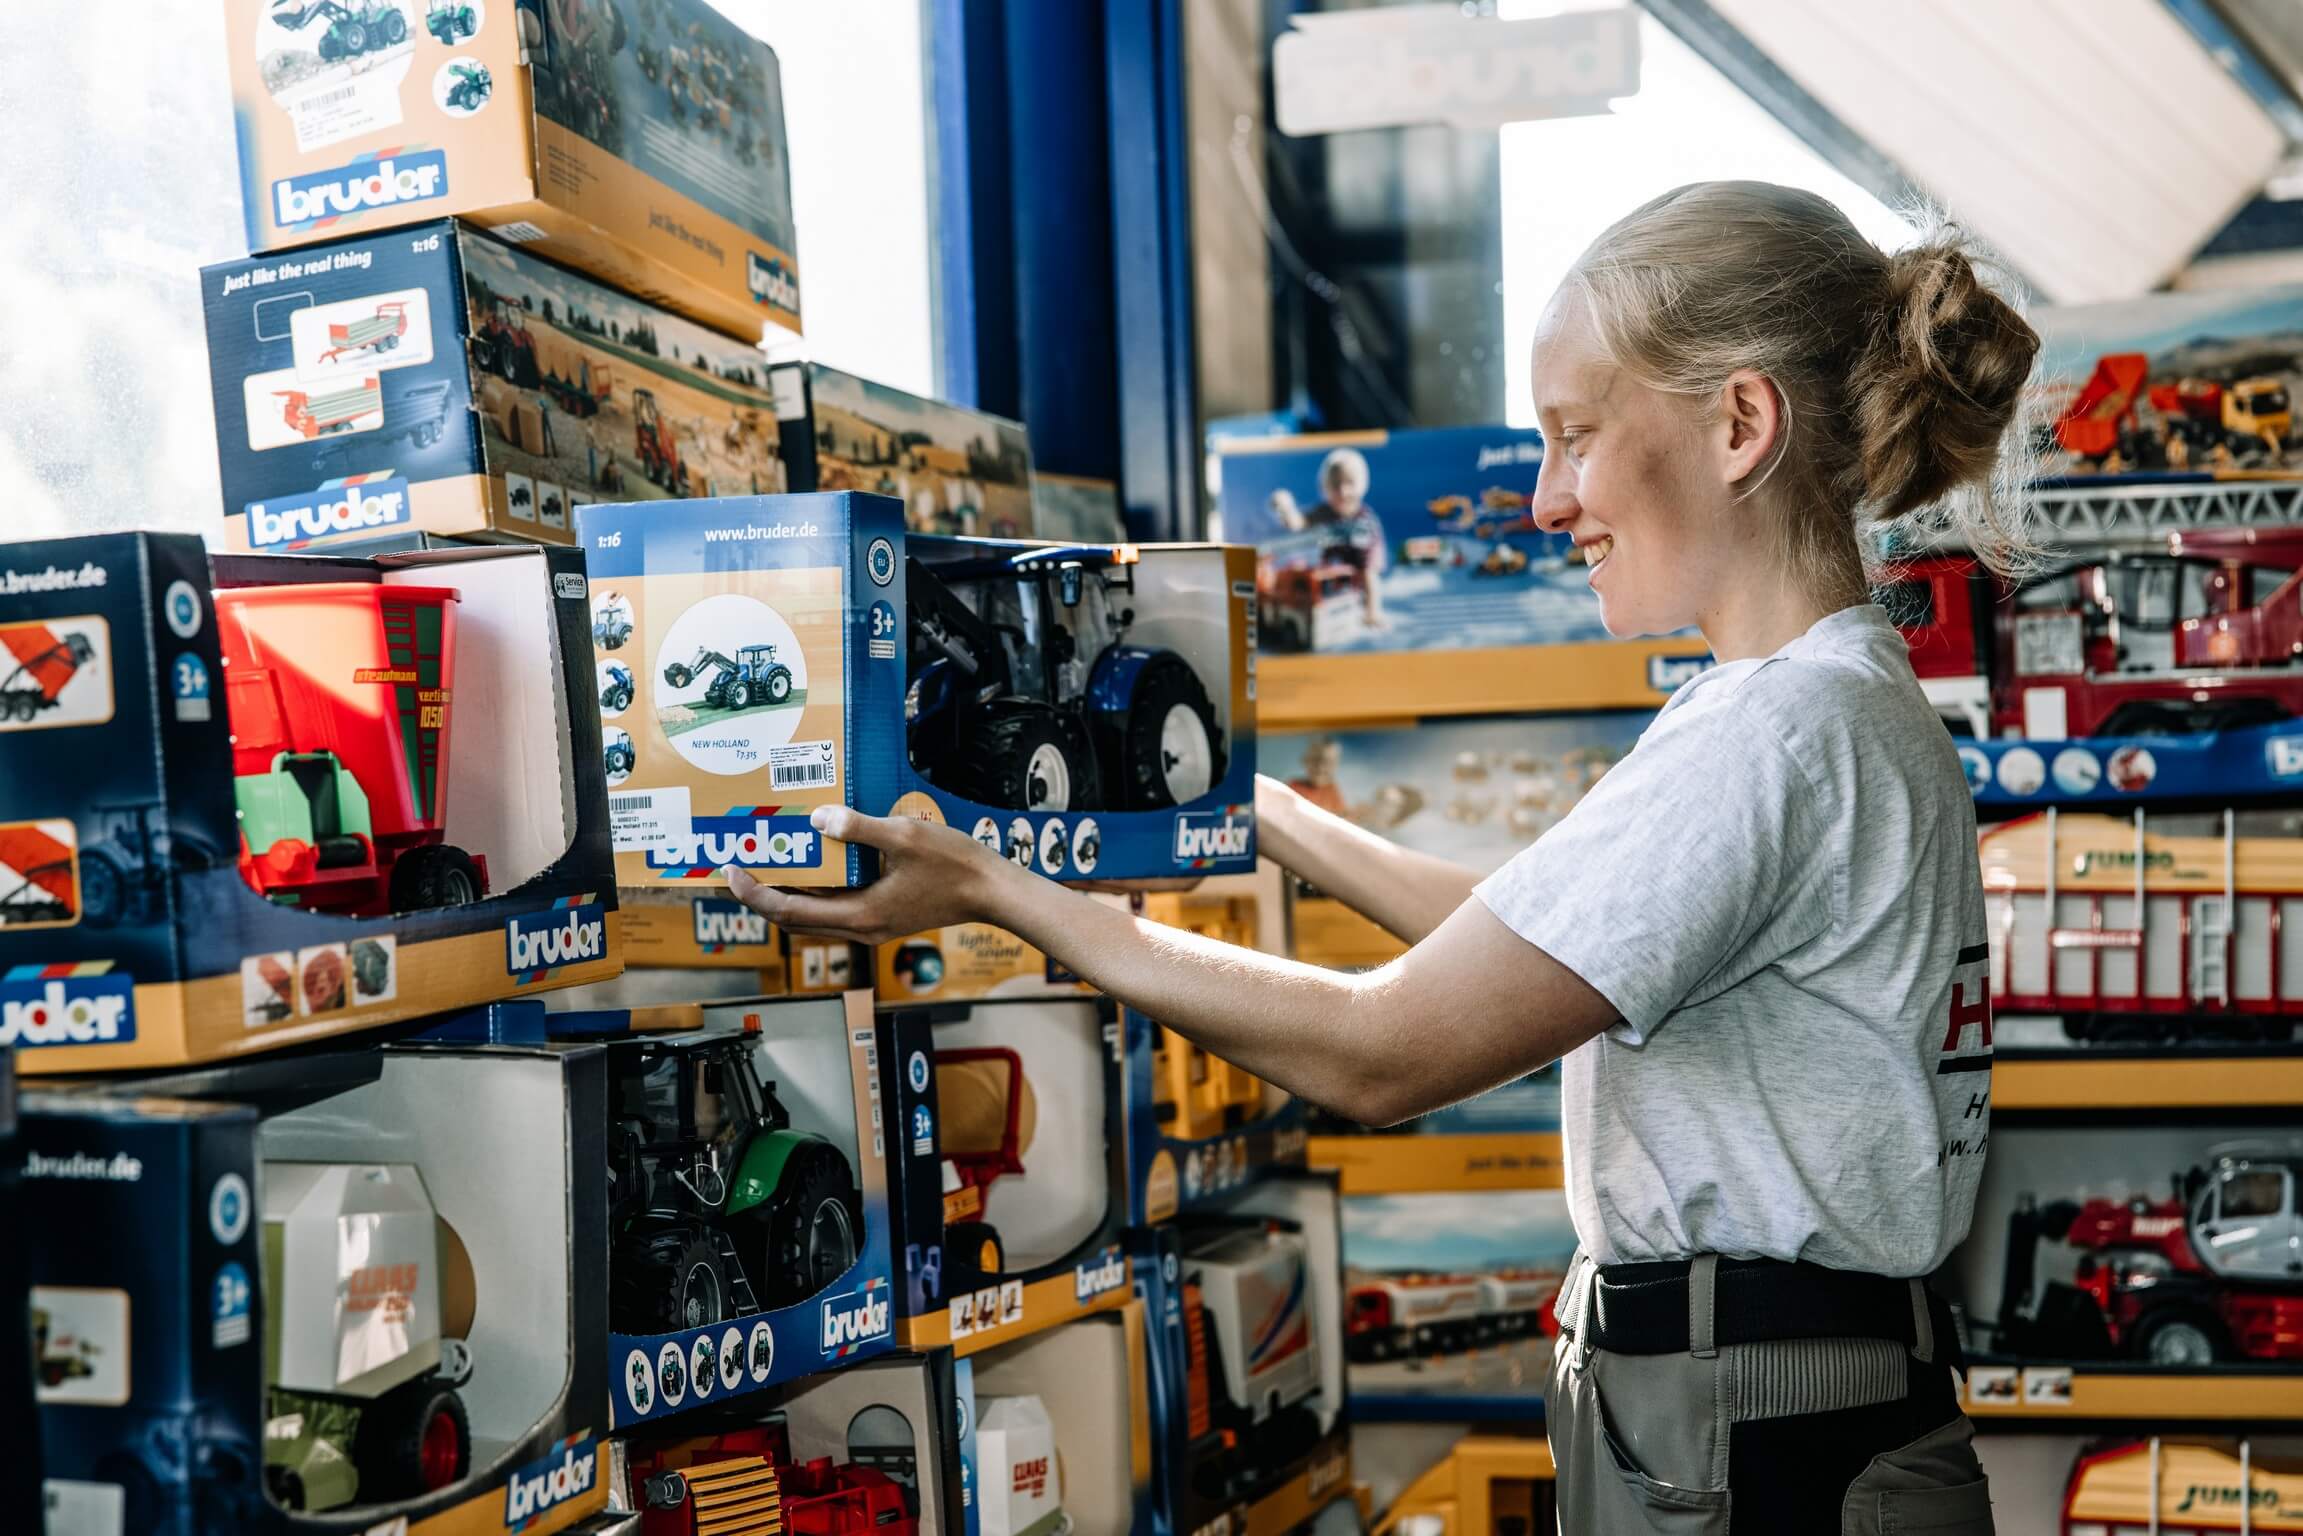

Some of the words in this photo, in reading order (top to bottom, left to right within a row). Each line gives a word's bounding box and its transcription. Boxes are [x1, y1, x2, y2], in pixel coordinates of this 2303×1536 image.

[277, 160, 439, 224] bruder
[411, 235, 439, 253] 1:16
[222, 274, 250, 297] just
[252, 266, 277, 286] like
[278, 262, 302, 281] the
[304, 256, 332, 276] real
[334, 251, 373, 270] thing
[252, 487, 404, 546] bruder
[704, 521, 819, 541] www.bruder.de
[598, 532, 622, 548] 1:16
[873, 607, 895, 636] 3+
[692, 740, 711, 748] NEW
[712, 738, 750, 748] HOLLAND
[1177, 815, 1248, 858] bruder
[510, 911, 602, 970] bruder
[824, 1293, 888, 1348] bruder
[507, 1448, 595, 1524] bruder
